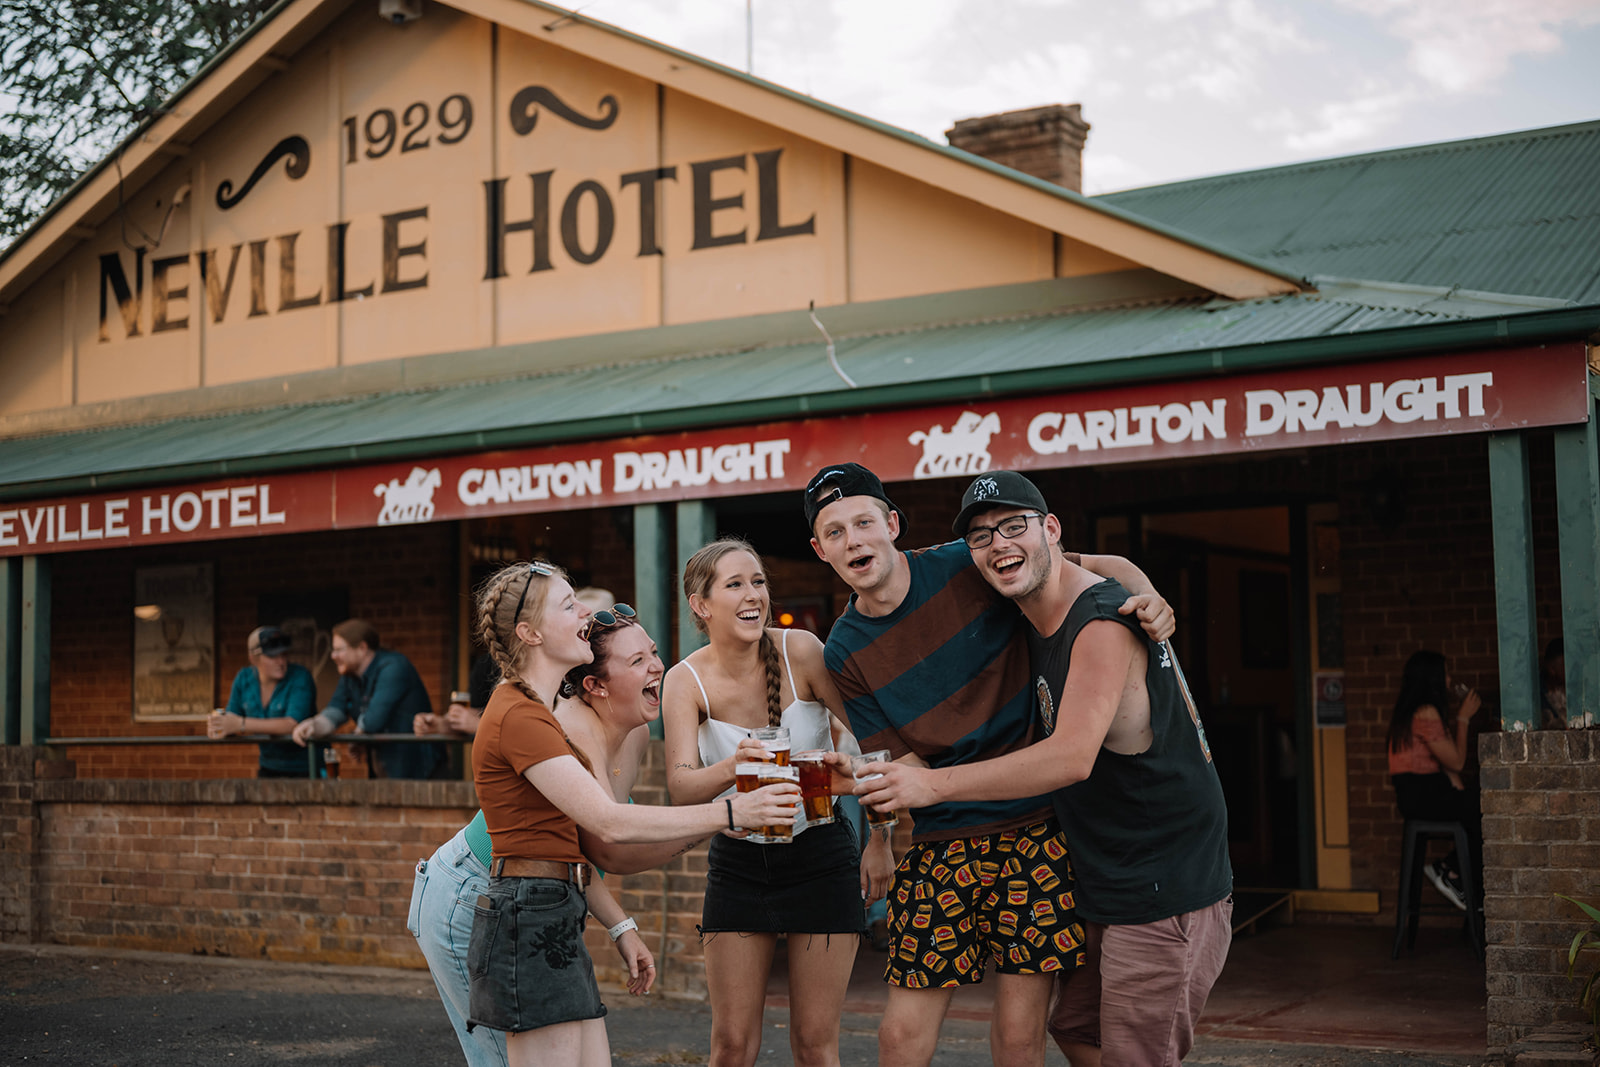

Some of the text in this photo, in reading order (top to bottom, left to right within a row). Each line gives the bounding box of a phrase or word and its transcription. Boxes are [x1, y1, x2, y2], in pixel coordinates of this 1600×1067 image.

[343, 94, 474, 165] 1929
[98, 147, 816, 344] NEVILLE HOTEL
[1027, 371, 1493, 456] CARLTON DRAUGHT
[457, 459, 602, 507] CARLTON
[613, 439, 791, 493] DRAUGHT
[141, 484, 286, 535] HOTEL
